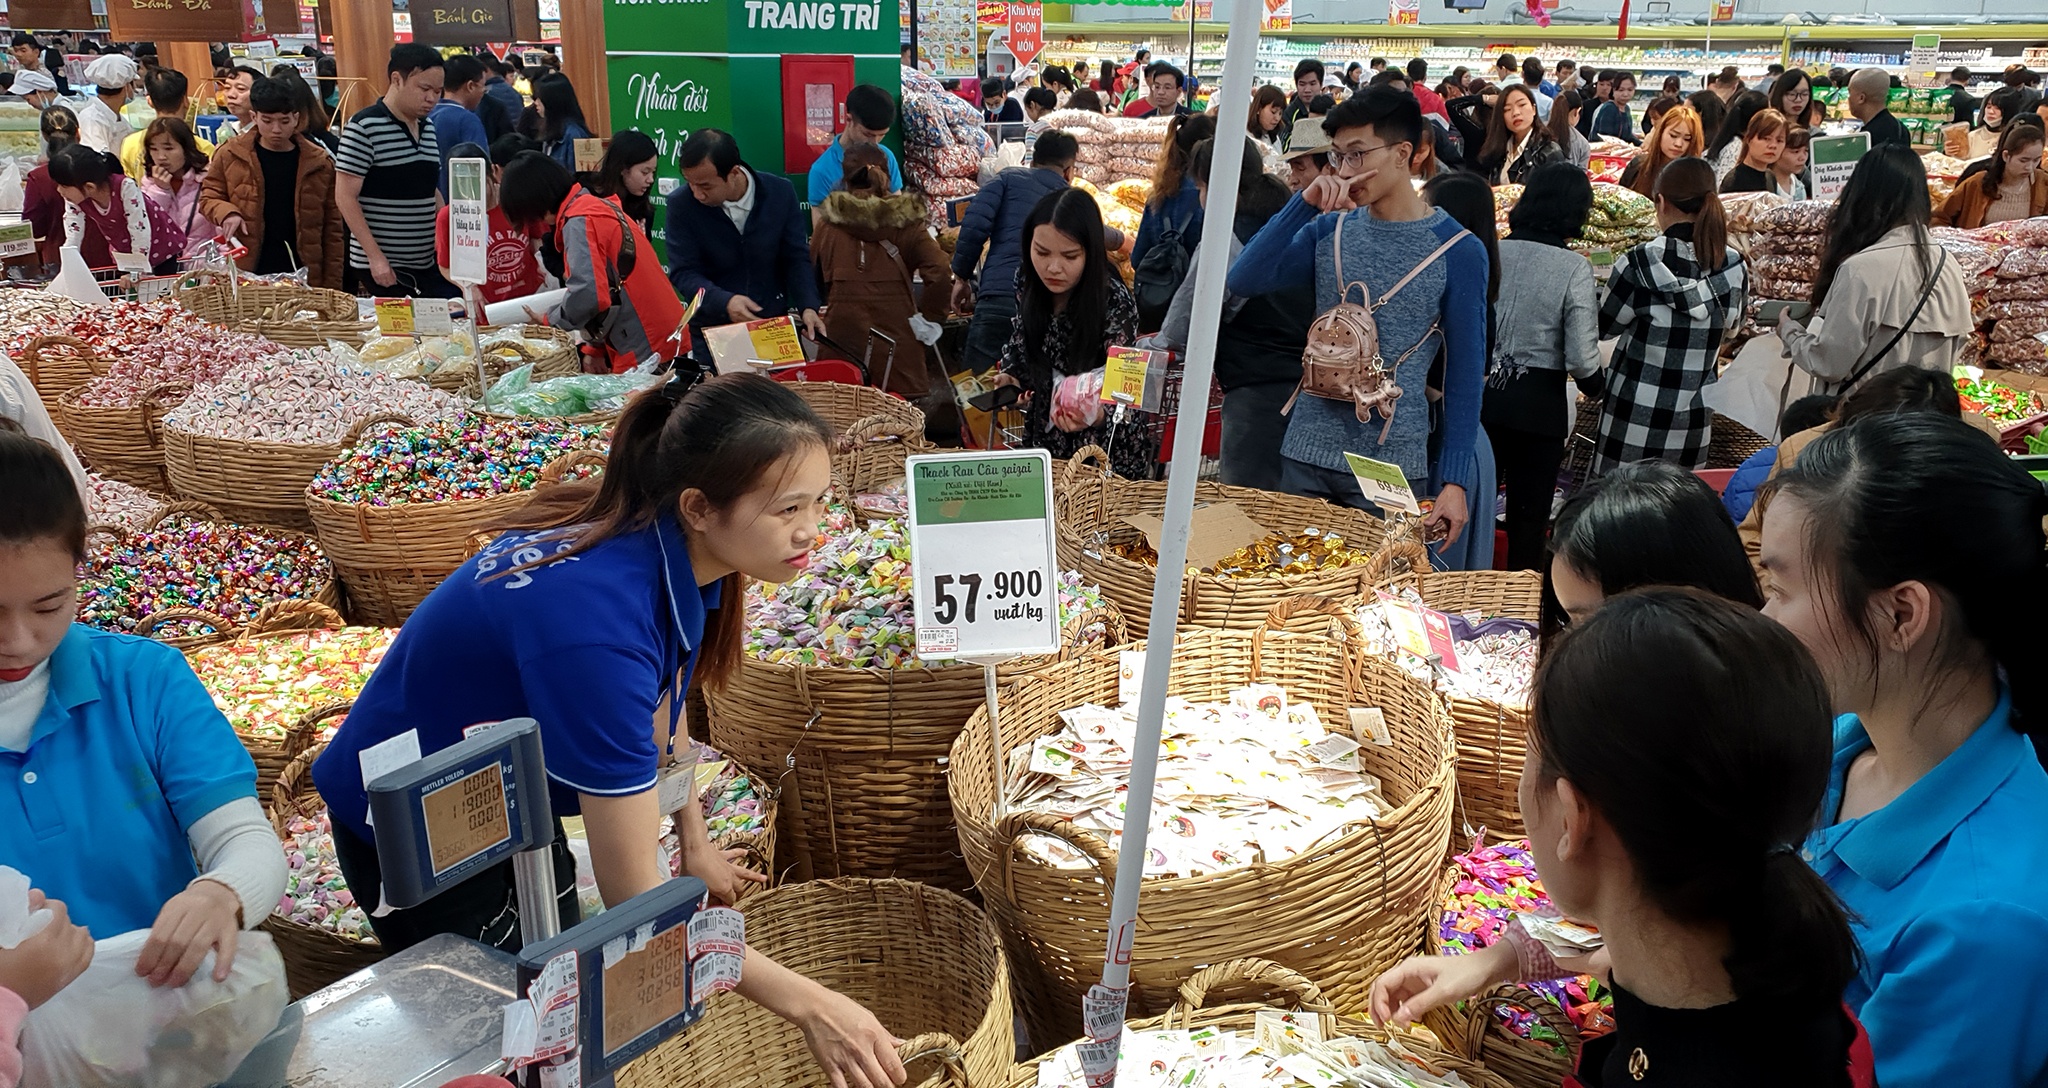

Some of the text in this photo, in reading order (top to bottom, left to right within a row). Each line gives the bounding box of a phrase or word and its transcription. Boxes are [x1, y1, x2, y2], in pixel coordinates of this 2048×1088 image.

[433, 7, 467, 24] Bánh
[744, 0, 881, 30] TRANG TRÍ
[1011, 5, 1041, 19] Khu Vực
[1015, 22, 1037, 35] CHỌN
[1017, 38, 1034, 52] MÓN
[487, 271, 512, 283] SINCE
[920, 464, 950, 482] Thạch
[951, 464, 975, 478] Rau
[977, 463, 999, 477] Câu
[994, 602, 1043, 622] vnđ/kg
[502, 764, 513, 774] kg
[421, 769, 465, 794] METTLER TOLEDO
[509, 799, 516, 810] $
